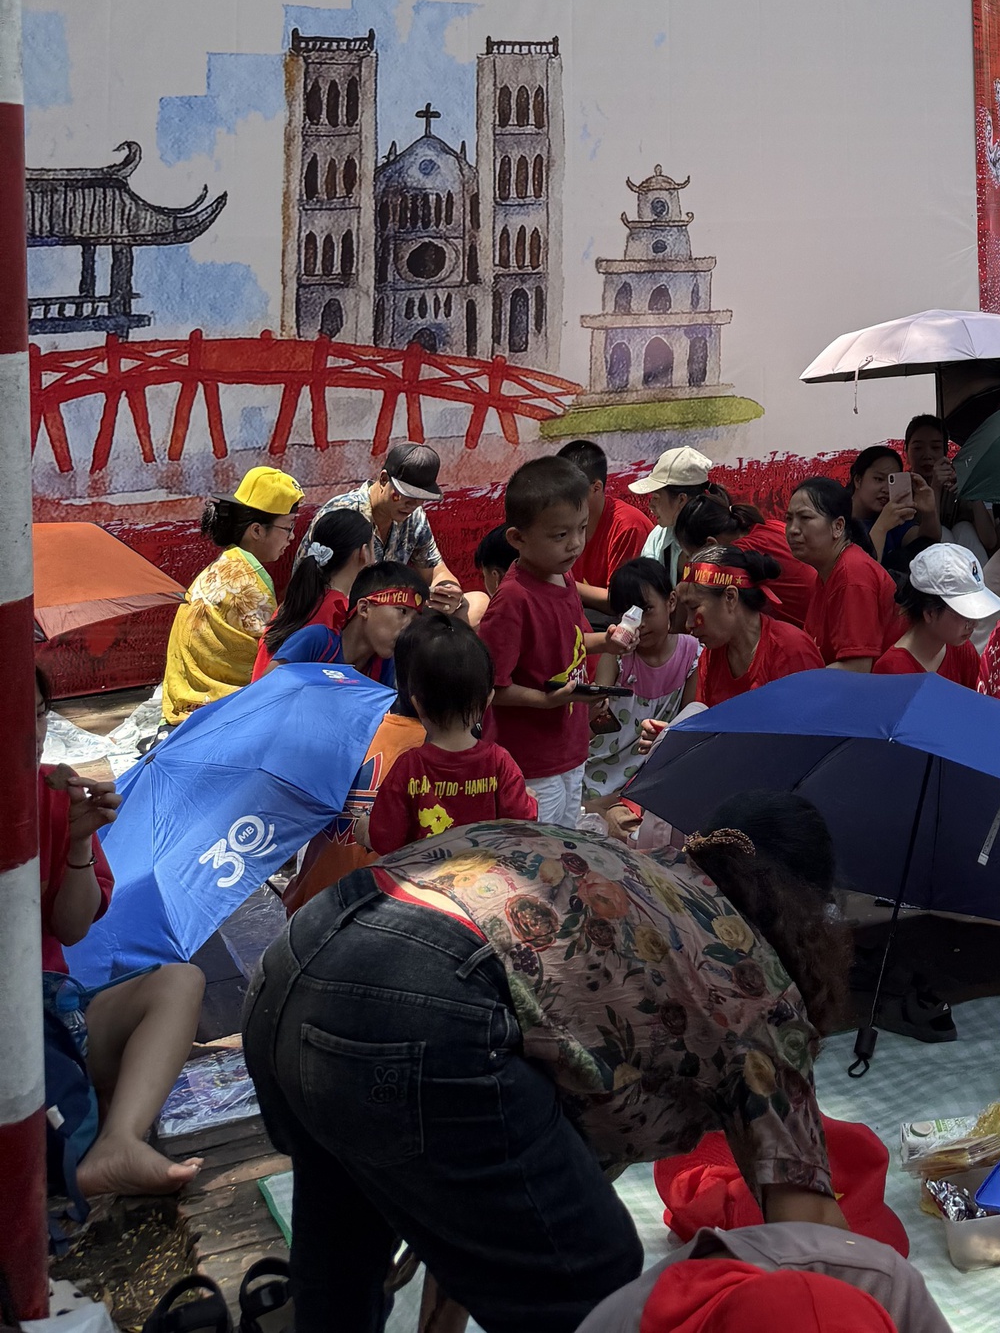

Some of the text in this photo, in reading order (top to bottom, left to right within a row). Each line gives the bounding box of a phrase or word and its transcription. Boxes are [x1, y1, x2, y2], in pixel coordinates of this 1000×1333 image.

[713, 572, 733, 585] NAM
[392, 590, 408, 603] YÊU
[446, 781, 459, 797] DO
[465, 777, 488, 797] HẠNH
[238, 825, 255, 843] MB
